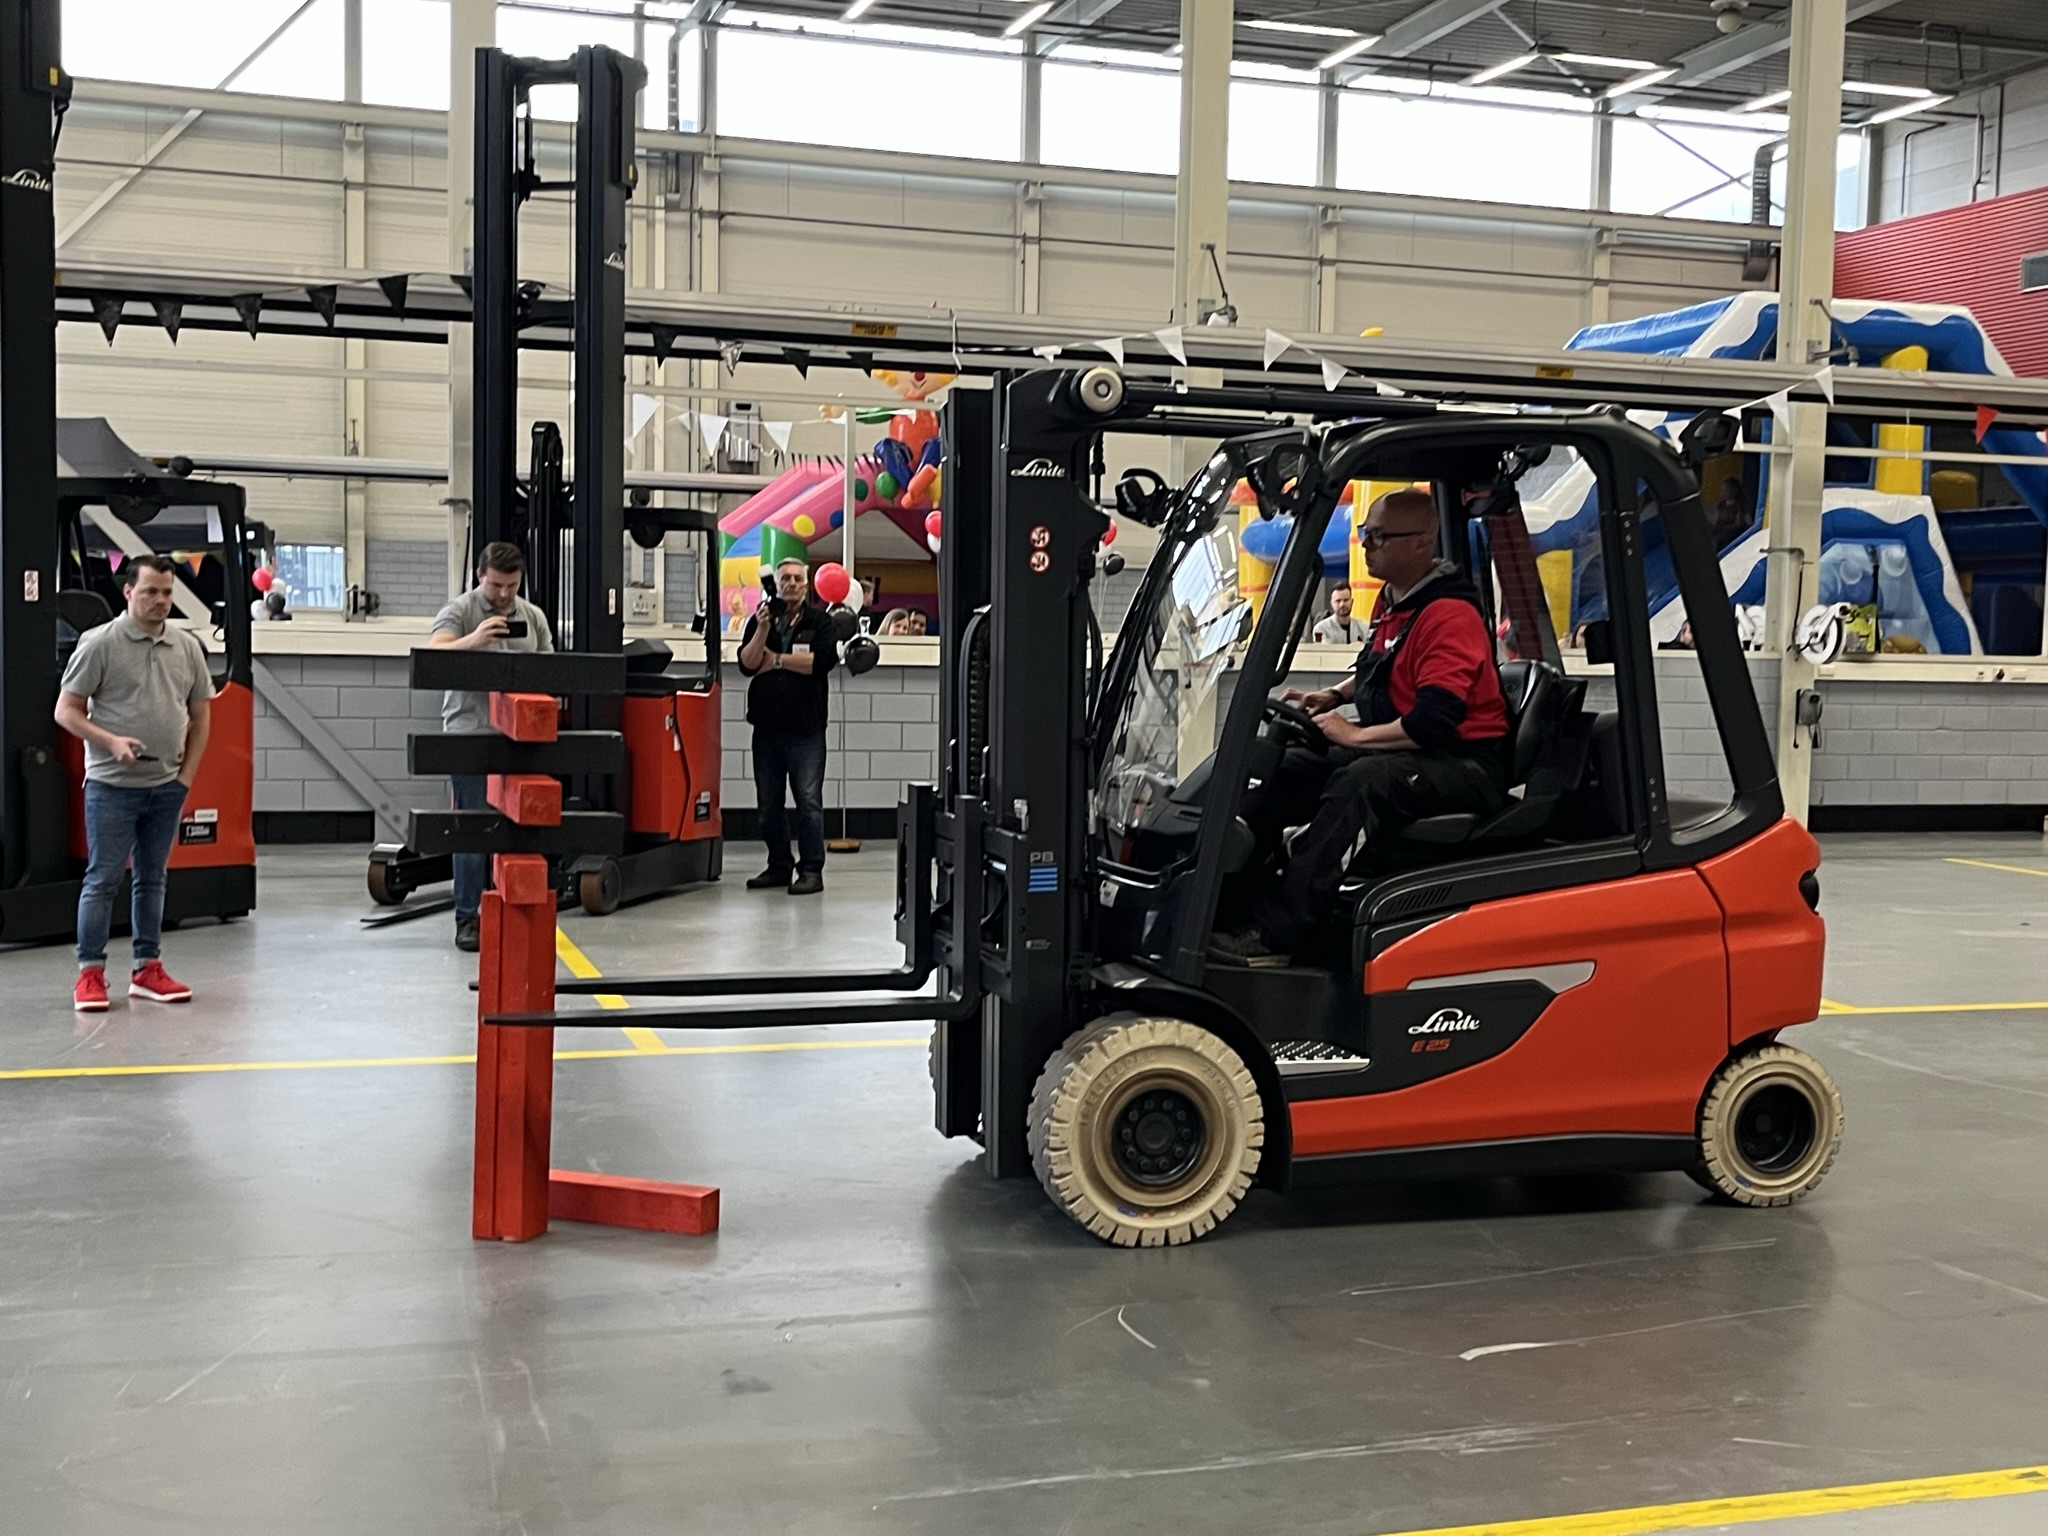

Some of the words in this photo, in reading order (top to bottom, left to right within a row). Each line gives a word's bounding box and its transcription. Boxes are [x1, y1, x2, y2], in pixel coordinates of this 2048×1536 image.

[1, 169, 51, 192] Linde
[1010, 458, 1066, 478] Linde
[1408, 1008, 1480, 1034] Linde
[1425, 1038, 1452, 1052] 25
